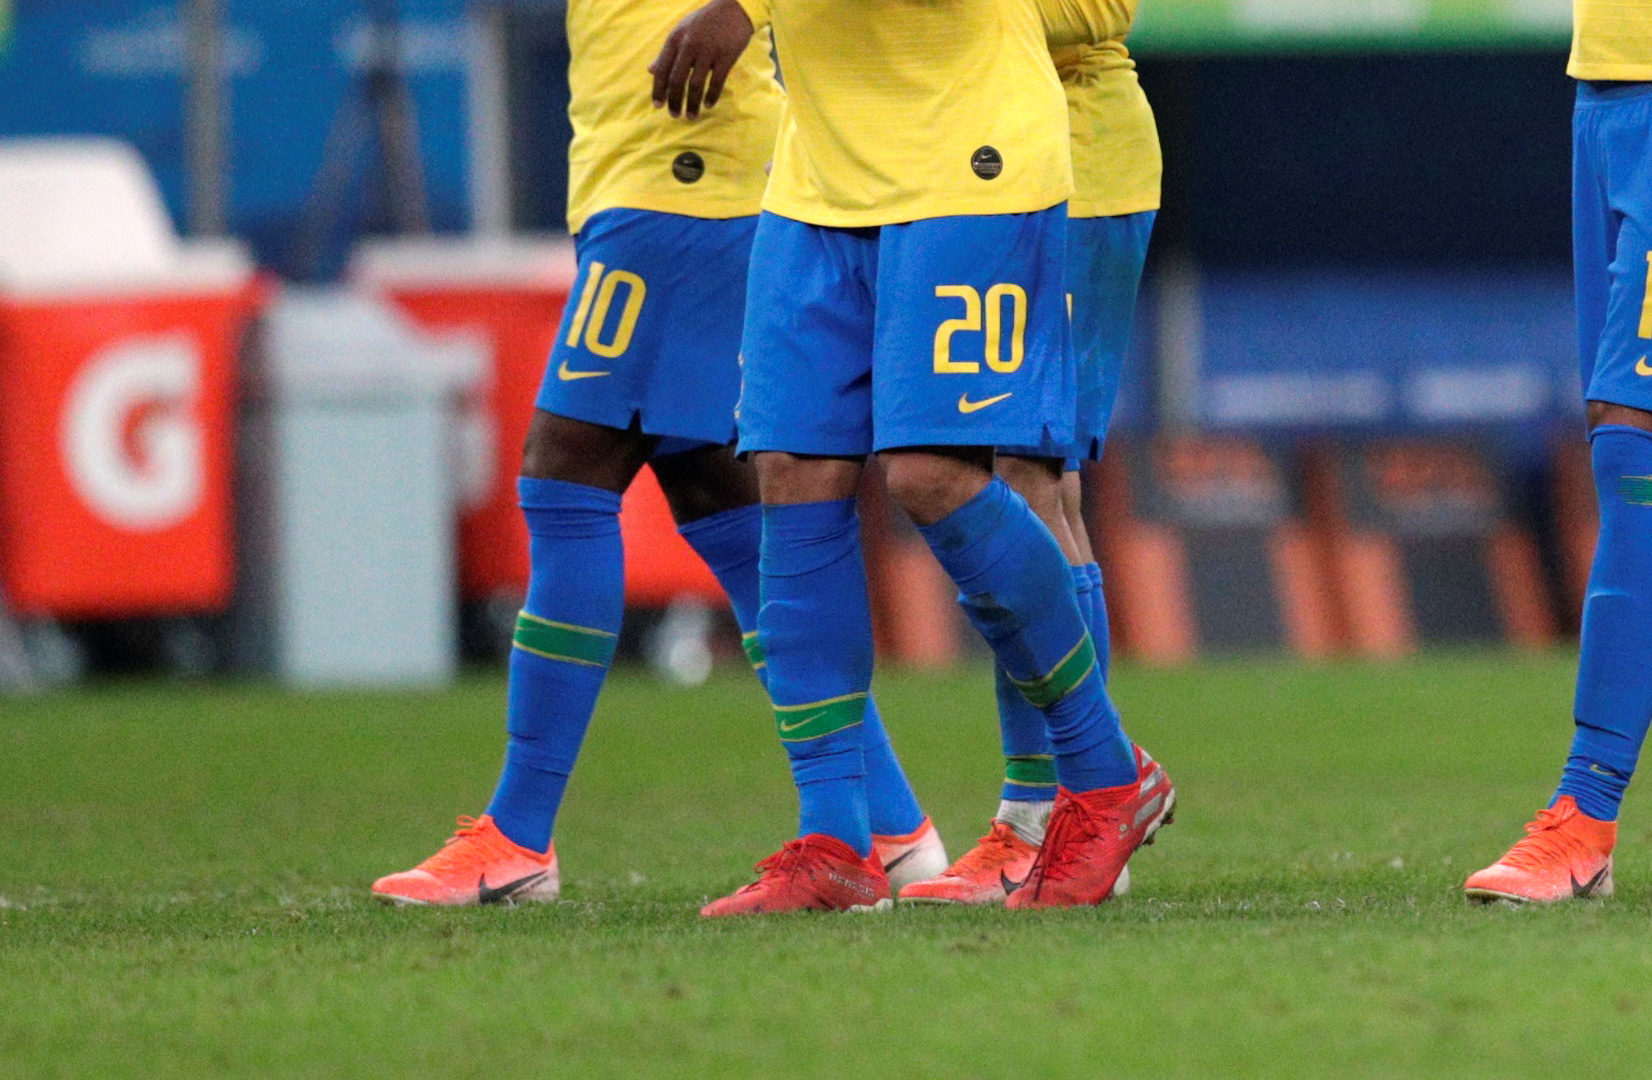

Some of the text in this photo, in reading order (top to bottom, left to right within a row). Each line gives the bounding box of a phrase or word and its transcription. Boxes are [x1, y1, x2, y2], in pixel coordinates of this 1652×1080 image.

[565, 261, 647, 358] 10
[933, 283, 1027, 374] 20
[62, 333, 203, 531] G
